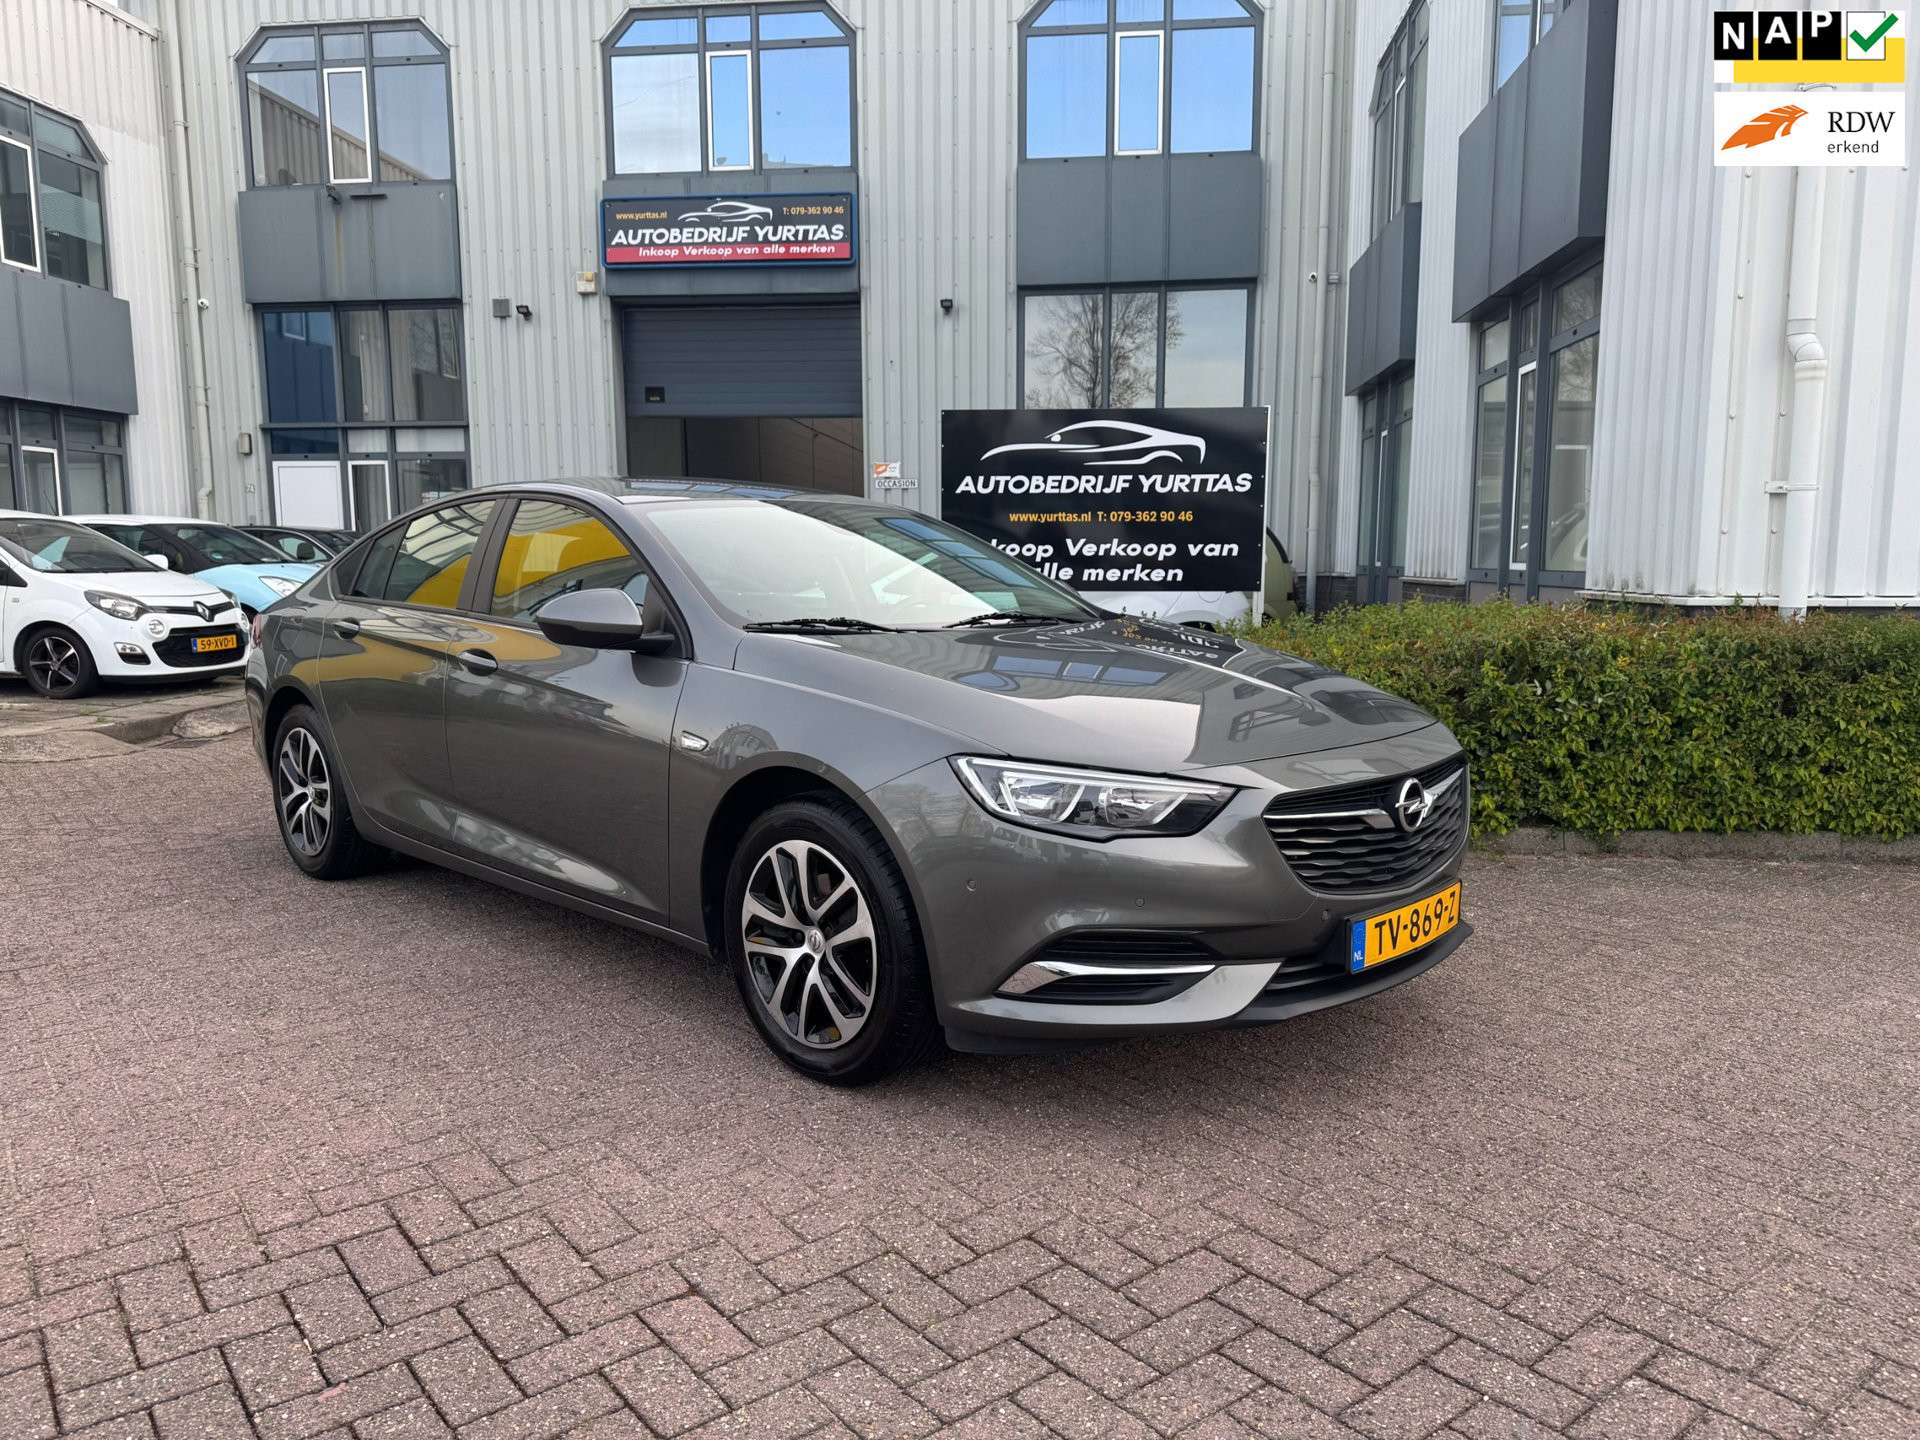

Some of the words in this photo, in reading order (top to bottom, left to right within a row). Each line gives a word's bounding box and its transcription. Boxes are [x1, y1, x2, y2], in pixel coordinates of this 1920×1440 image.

[615, 211, 668, 220] www.yurttas.nl
[783, 207, 790, 215] T:
[790, 206, 821, 215] 079-362
[822, 206, 832, 214] 90
[833, 206, 844, 214] 46
[611, 226, 750, 245] AUTOBEDRIJF
[754, 223, 845, 242] YURTTAS
[638, 246, 679, 258] Inkoop
[683, 244, 733, 257] Verkoop
[736, 246, 760, 255] van
[763, 244, 786, 254] alle
[789, 243, 836, 254] merken
[877, 480, 916, 488] OCCASION
[955, 475, 1133, 494] AUTOBEDRIJF
[1139, 473, 1253, 493] YURTTAS
[1009, 512, 1092, 523] www.yurttas.nl
[1097, 512, 1107, 522] T:
[1110, 511, 1157, 522] 079-362
[1160, 511, 1175, 522] 90
[1178, 511, 1193, 522] 46
[988, 538, 1054, 562] koop
[1065, 538, 1177, 562] Verkoop
[1187, 542, 1240, 557] van
[1034, 561, 1074, 581] lle
[1082, 564, 1184, 582] merken
[1374, 891, 1457, 956] TV-869-Z
[1353, 950, 1364, 962] NL
